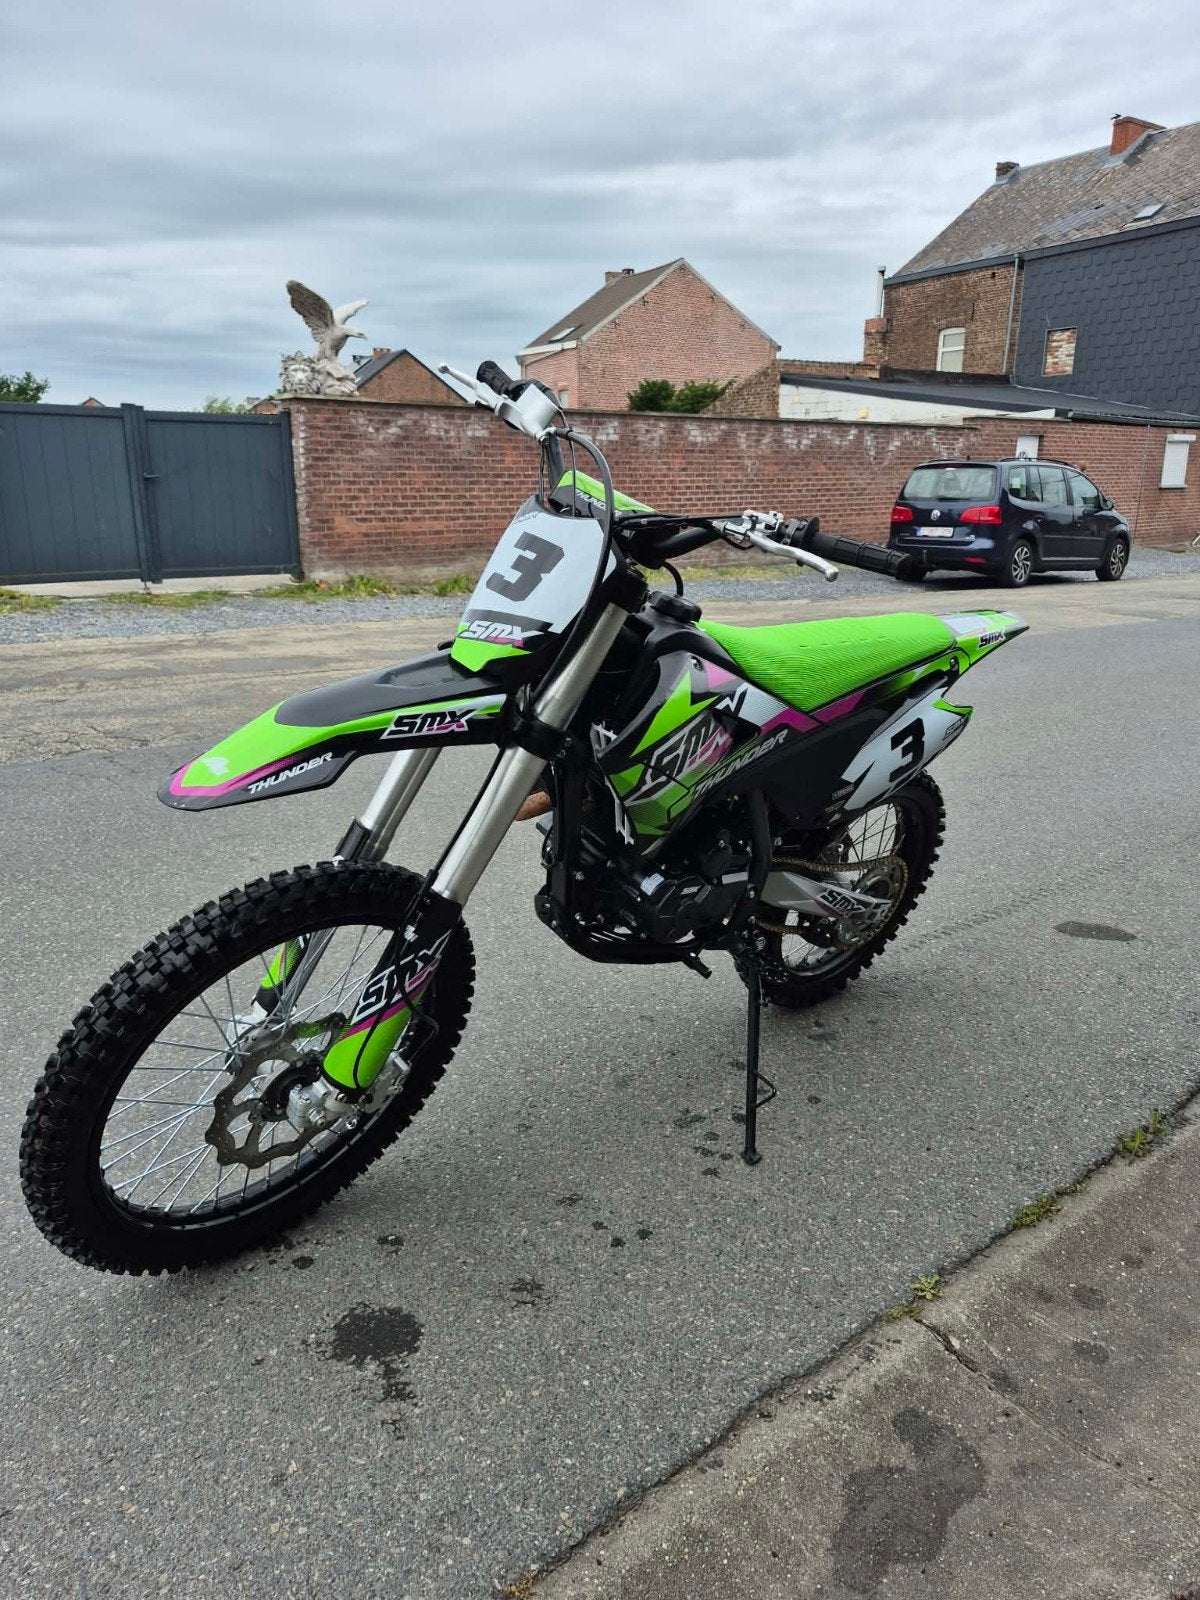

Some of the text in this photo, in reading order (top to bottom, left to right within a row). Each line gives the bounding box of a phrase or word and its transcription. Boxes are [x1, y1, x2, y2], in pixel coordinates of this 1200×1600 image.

[486, 531, 565, 602] 3
[461, 620, 544, 646] SMX
[381, 708, 475, 740] SMX
[889, 717, 925, 783] 3
[248, 752, 333, 794] THUNDER
[693, 728, 788, 800] THUNDER
